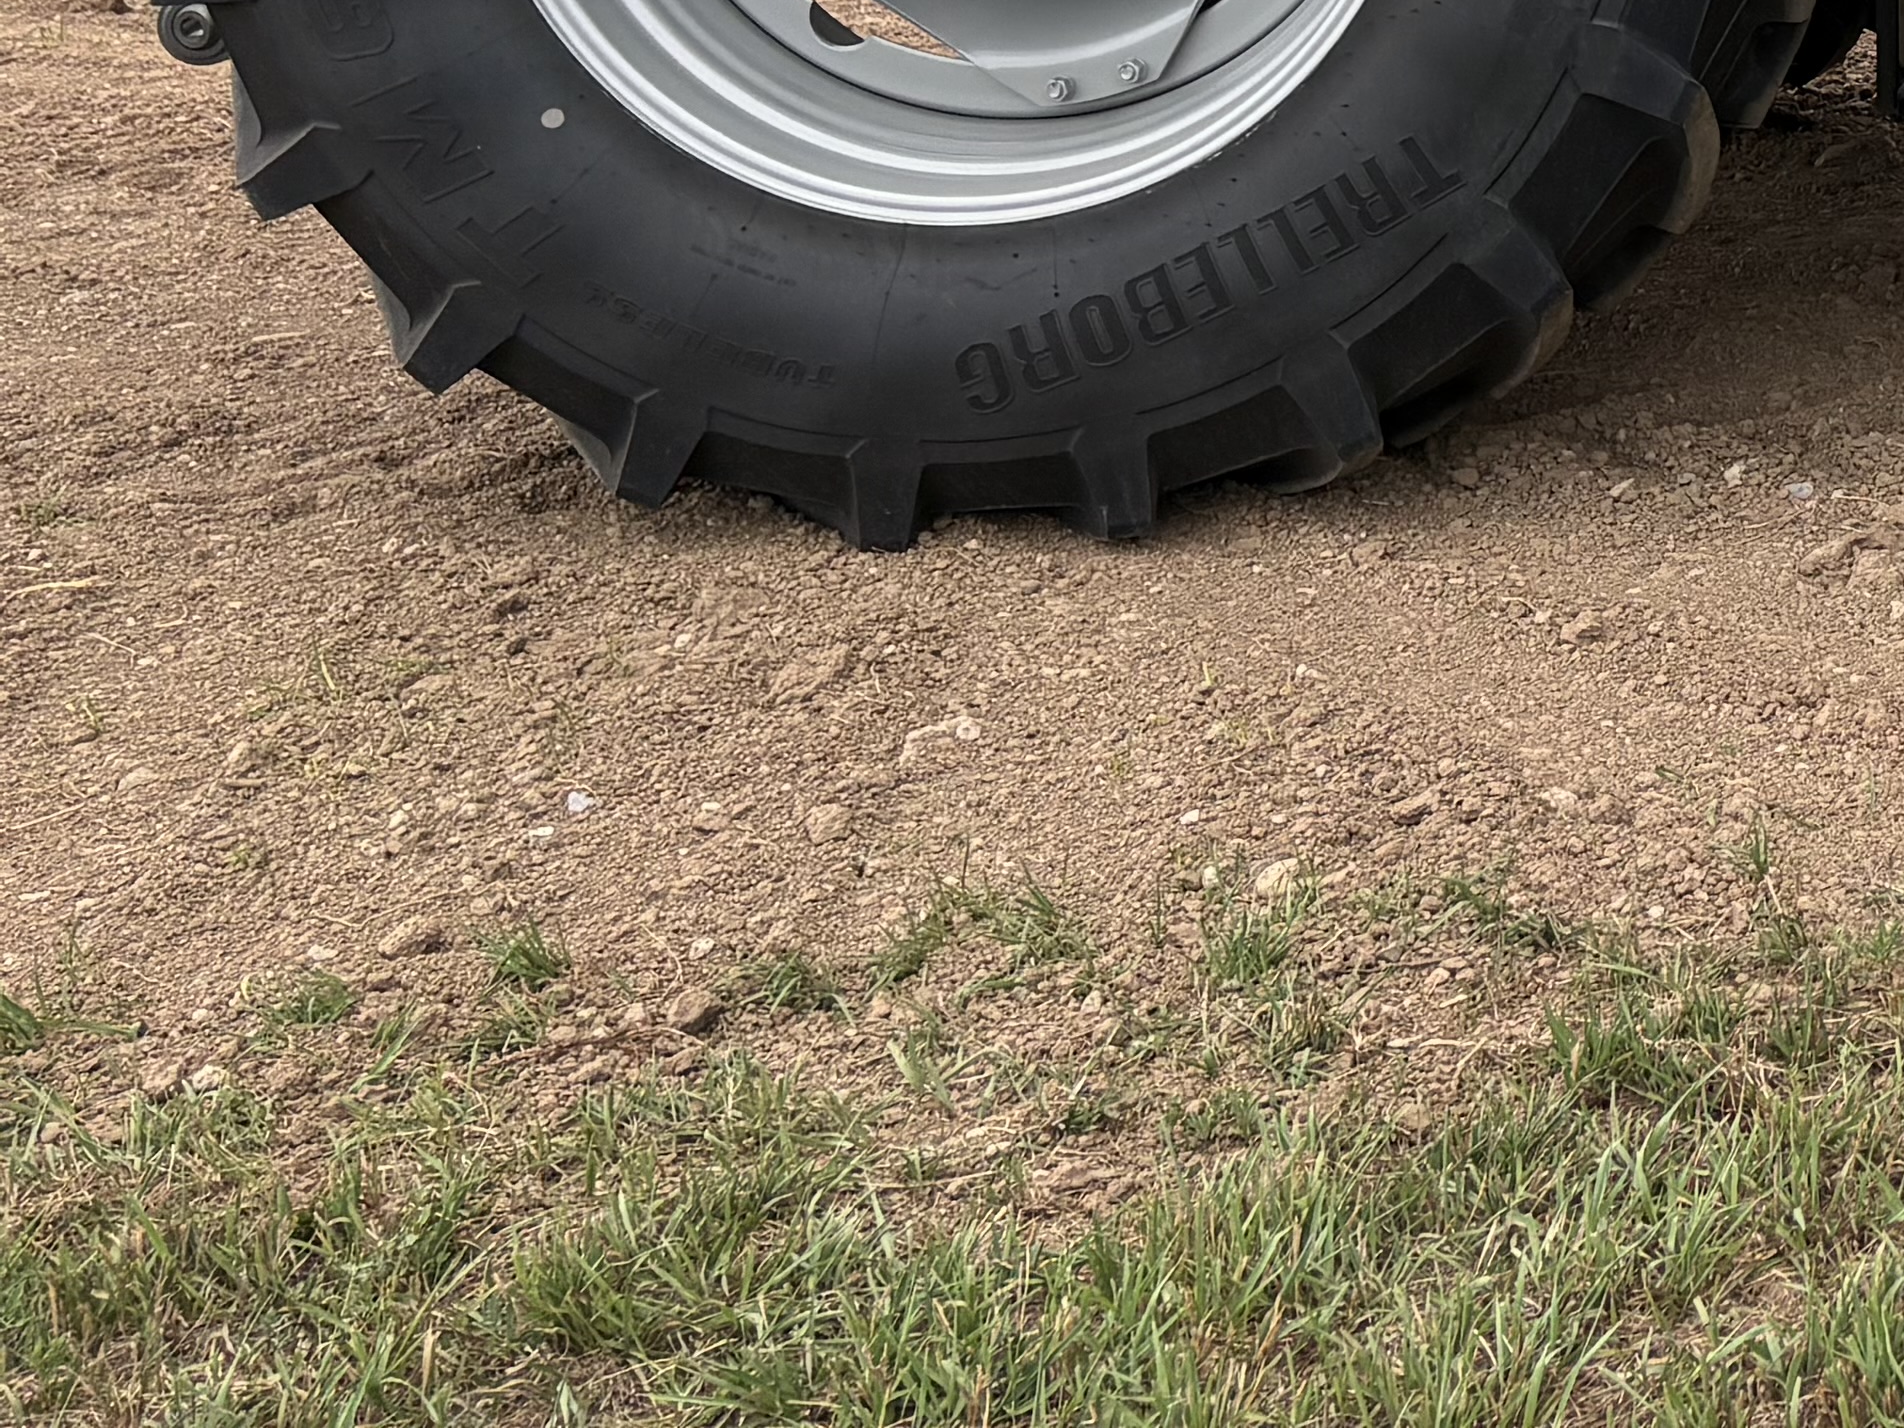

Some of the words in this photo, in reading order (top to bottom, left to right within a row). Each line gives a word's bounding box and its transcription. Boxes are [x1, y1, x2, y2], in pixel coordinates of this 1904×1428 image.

[347, 75, 565, 289] TM
[954, 135, 1468, 414] TRELLEBORG
[584, 280, 837, 388] TUBELESS
